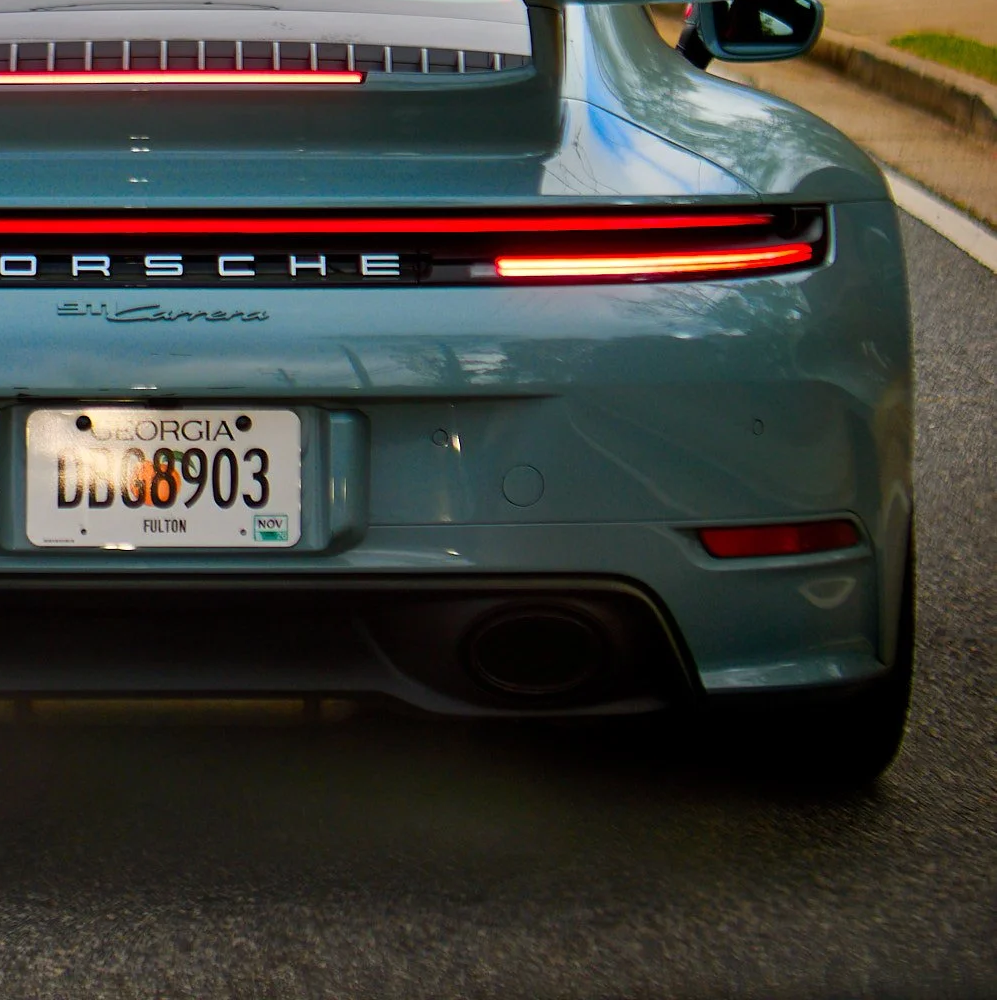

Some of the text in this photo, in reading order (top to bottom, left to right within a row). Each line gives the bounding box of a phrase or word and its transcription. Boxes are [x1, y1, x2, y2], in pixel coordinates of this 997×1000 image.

[57, 302, 270, 323] 911 Carrera
[90, 419, 236, 442] GEORGIA
[143, 519, 187, 534] FULTON
[258, 519, 283, 529] NOV
